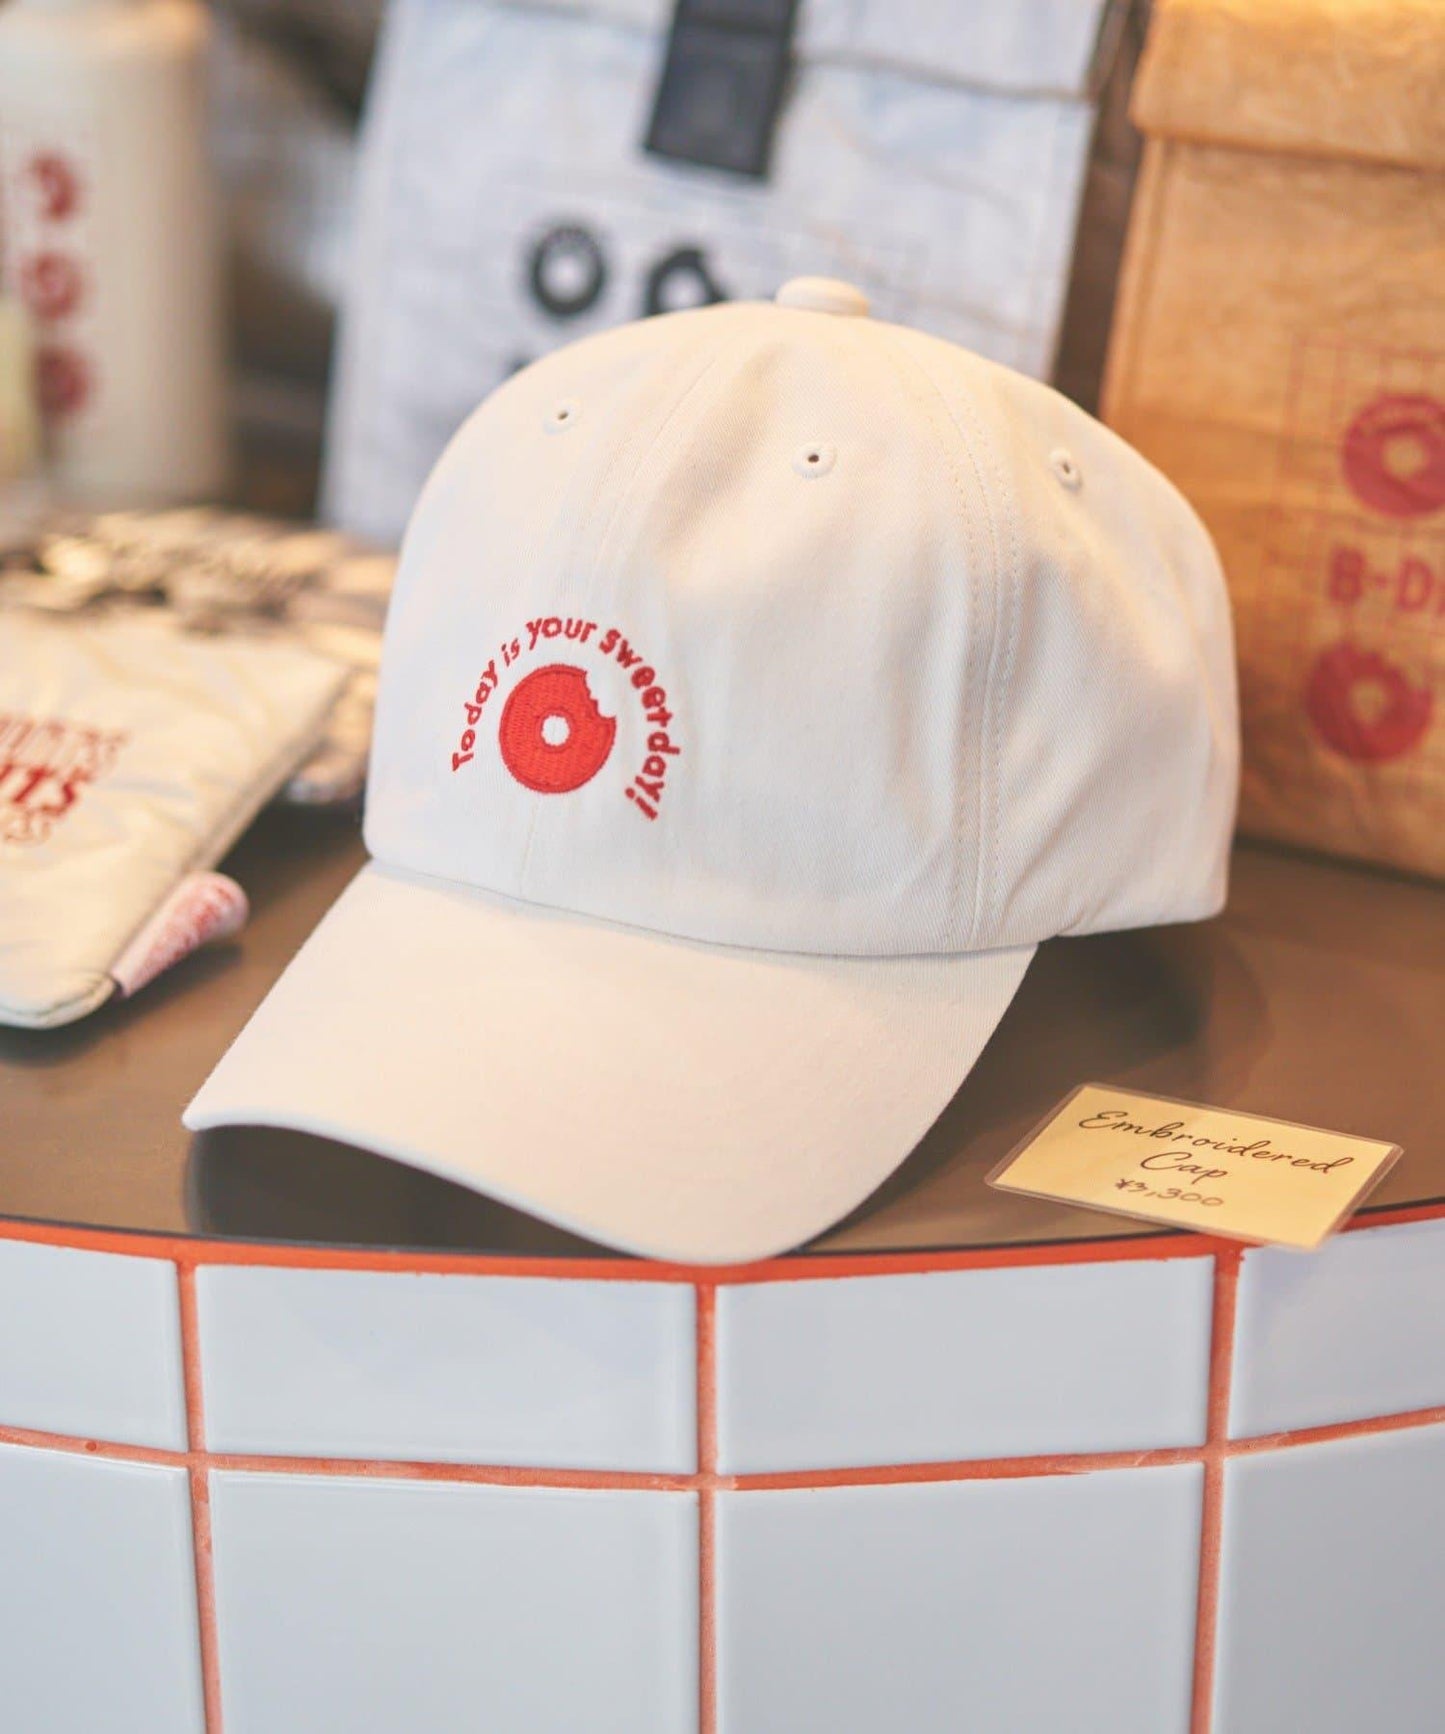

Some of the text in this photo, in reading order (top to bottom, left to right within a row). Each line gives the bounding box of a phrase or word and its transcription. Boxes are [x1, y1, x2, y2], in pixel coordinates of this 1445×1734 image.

[451, 659, 498, 772] Today
[501, 637, 520, 668] is
[526, 617, 598, 650] your
[1078, 1110, 1355, 1174] Embroidered
[1139, 1150, 1229, 1184] Cap
[1114, 1178, 1225, 1207] ¥3,300
